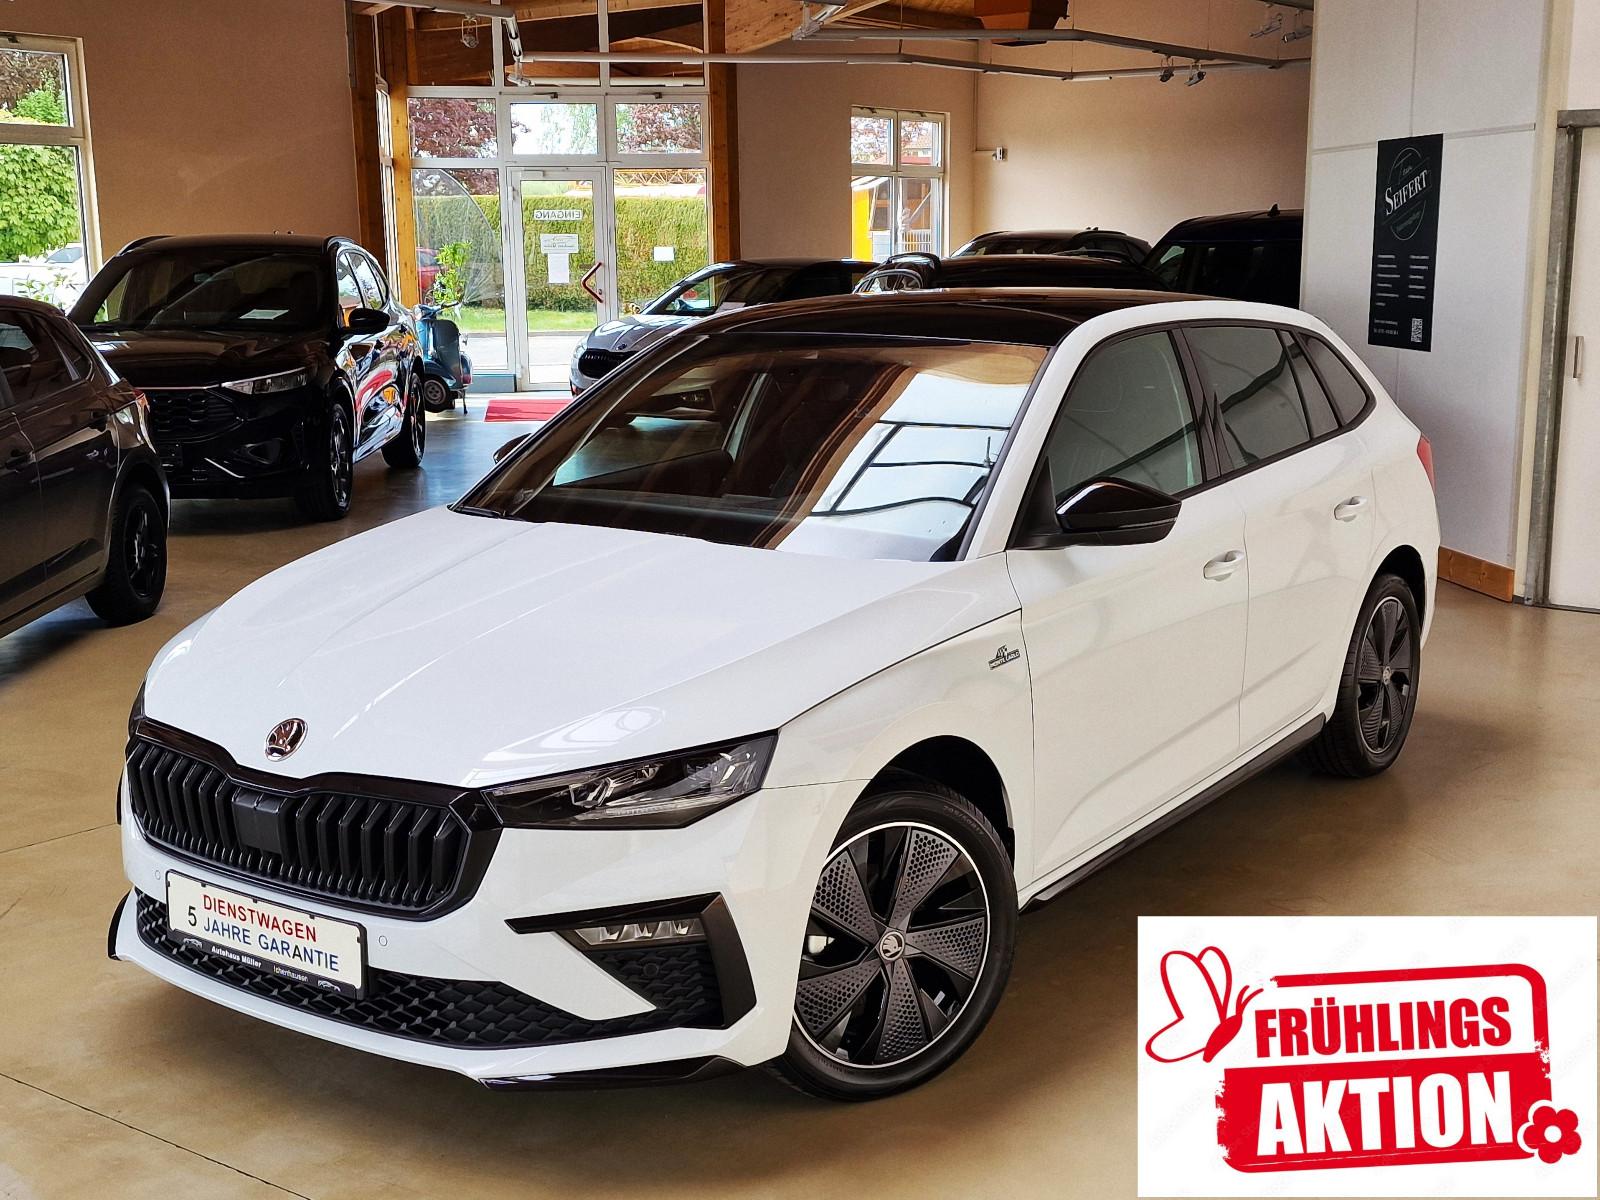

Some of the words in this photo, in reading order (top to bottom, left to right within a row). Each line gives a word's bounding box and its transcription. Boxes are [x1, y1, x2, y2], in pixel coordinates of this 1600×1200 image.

[1385, 169, 1428, 216] SEIFERT
[188, 905, 197, 927] 5
[203, 917, 251, 945] JAHRE
[258, 933, 339, 972] GARANTIE
[203, 894, 317, 942] DIENSTWAGEN
[211, 945, 241, 962] Autohaus
[241, 954, 262, 968] Müller
